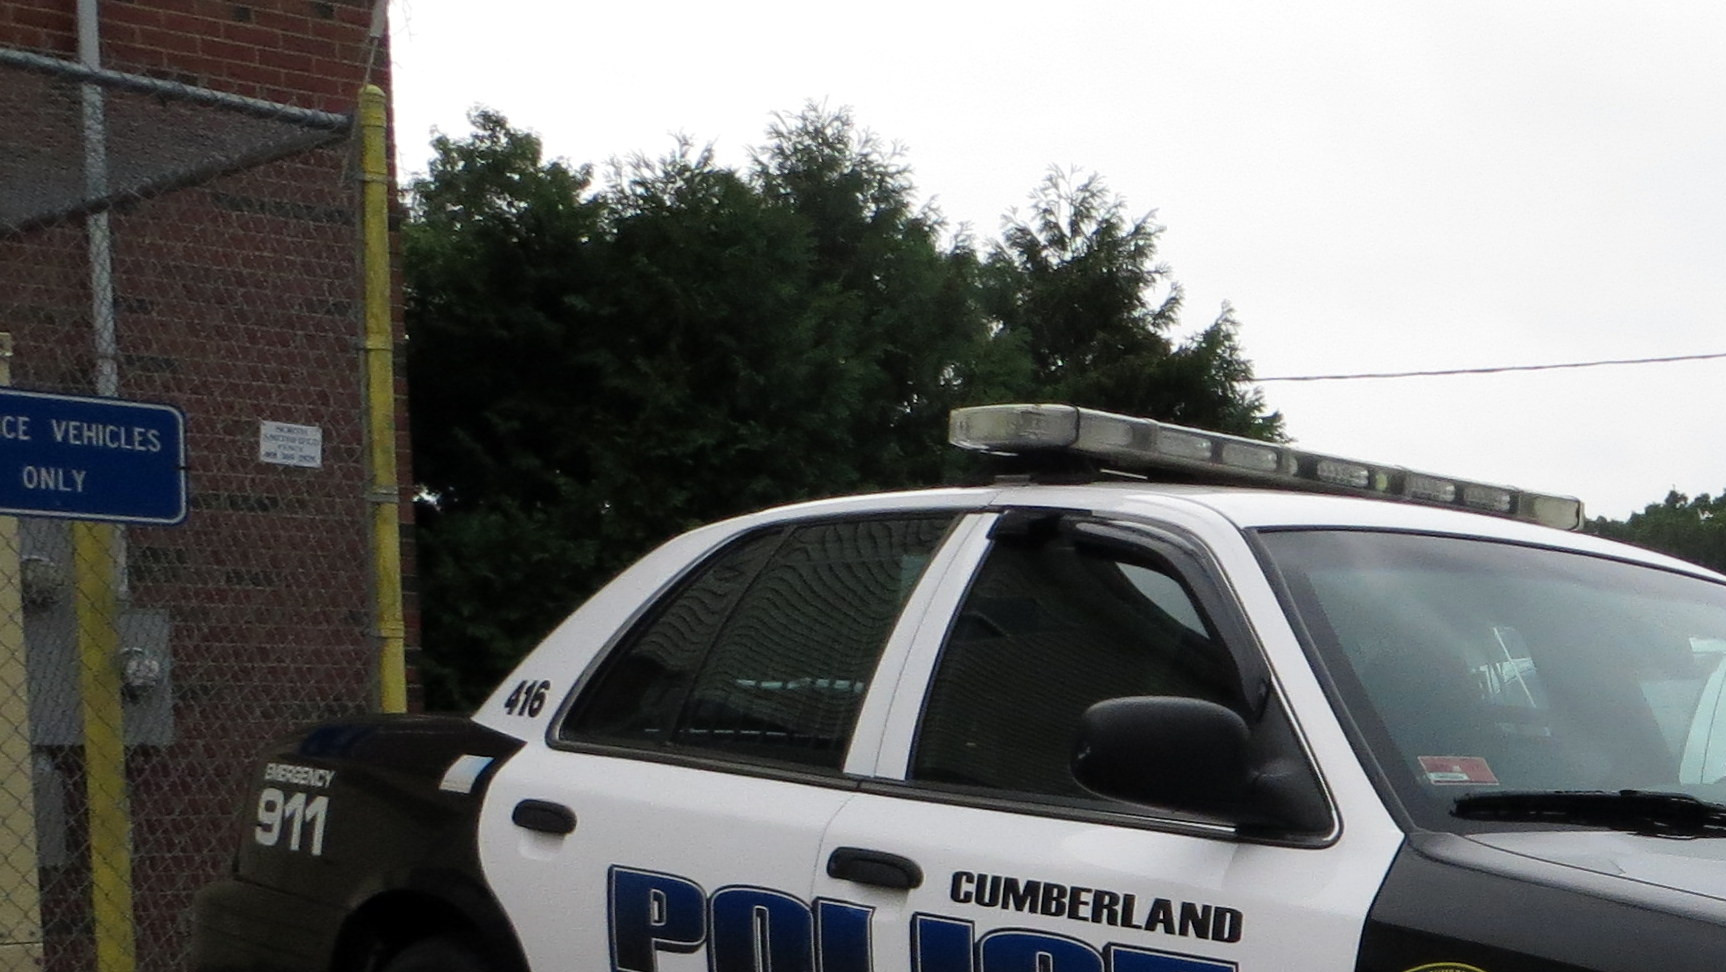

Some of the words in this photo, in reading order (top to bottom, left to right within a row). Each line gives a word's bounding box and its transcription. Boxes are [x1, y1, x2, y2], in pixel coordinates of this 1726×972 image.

[0, 416, 31, 440] CE
[52, 419, 161, 452] VEHICLES
[23, 466, 86, 492] ONLY
[504, 679, 551, 719] 416
[264, 763, 337, 789] EMERGENCY
[255, 788, 329, 857] 911
[950, 870, 1243, 943] CUMBERLAND
